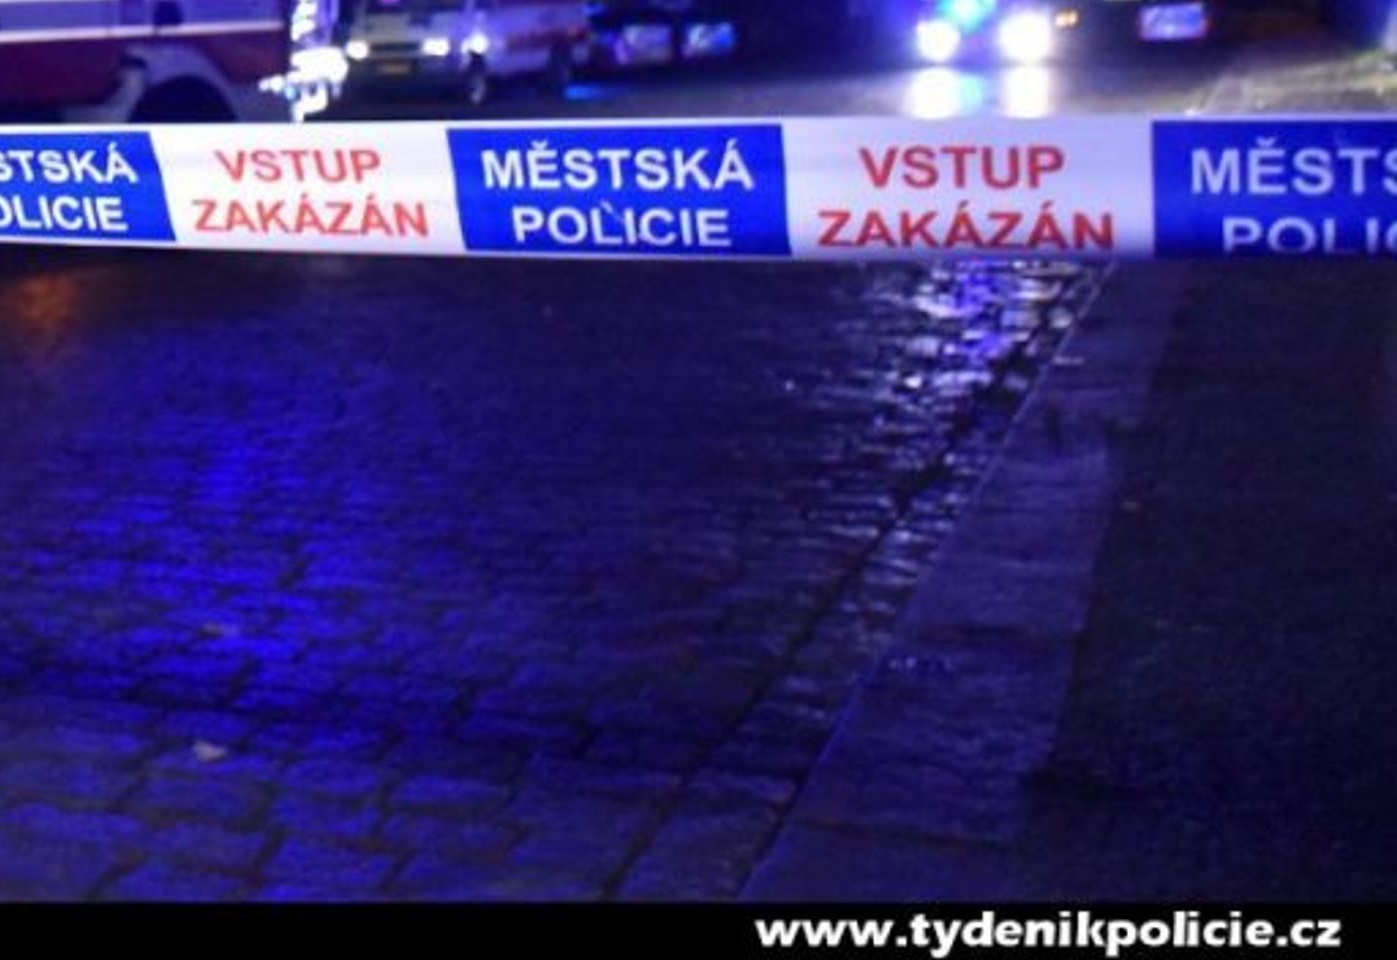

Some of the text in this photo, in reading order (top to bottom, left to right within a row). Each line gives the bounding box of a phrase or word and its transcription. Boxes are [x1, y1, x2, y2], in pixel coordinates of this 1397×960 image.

[213, 149, 381, 183] VSTUP
[480, 138, 754, 190] MĚSTSKÁ
[858, 144, 1065, 189] VSTUP
[191, 193, 429, 237] ZAKÁZÁN
[511, 200, 732, 247] POLICIE
[817, 200, 1114, 249] ZAKÁZÁN
